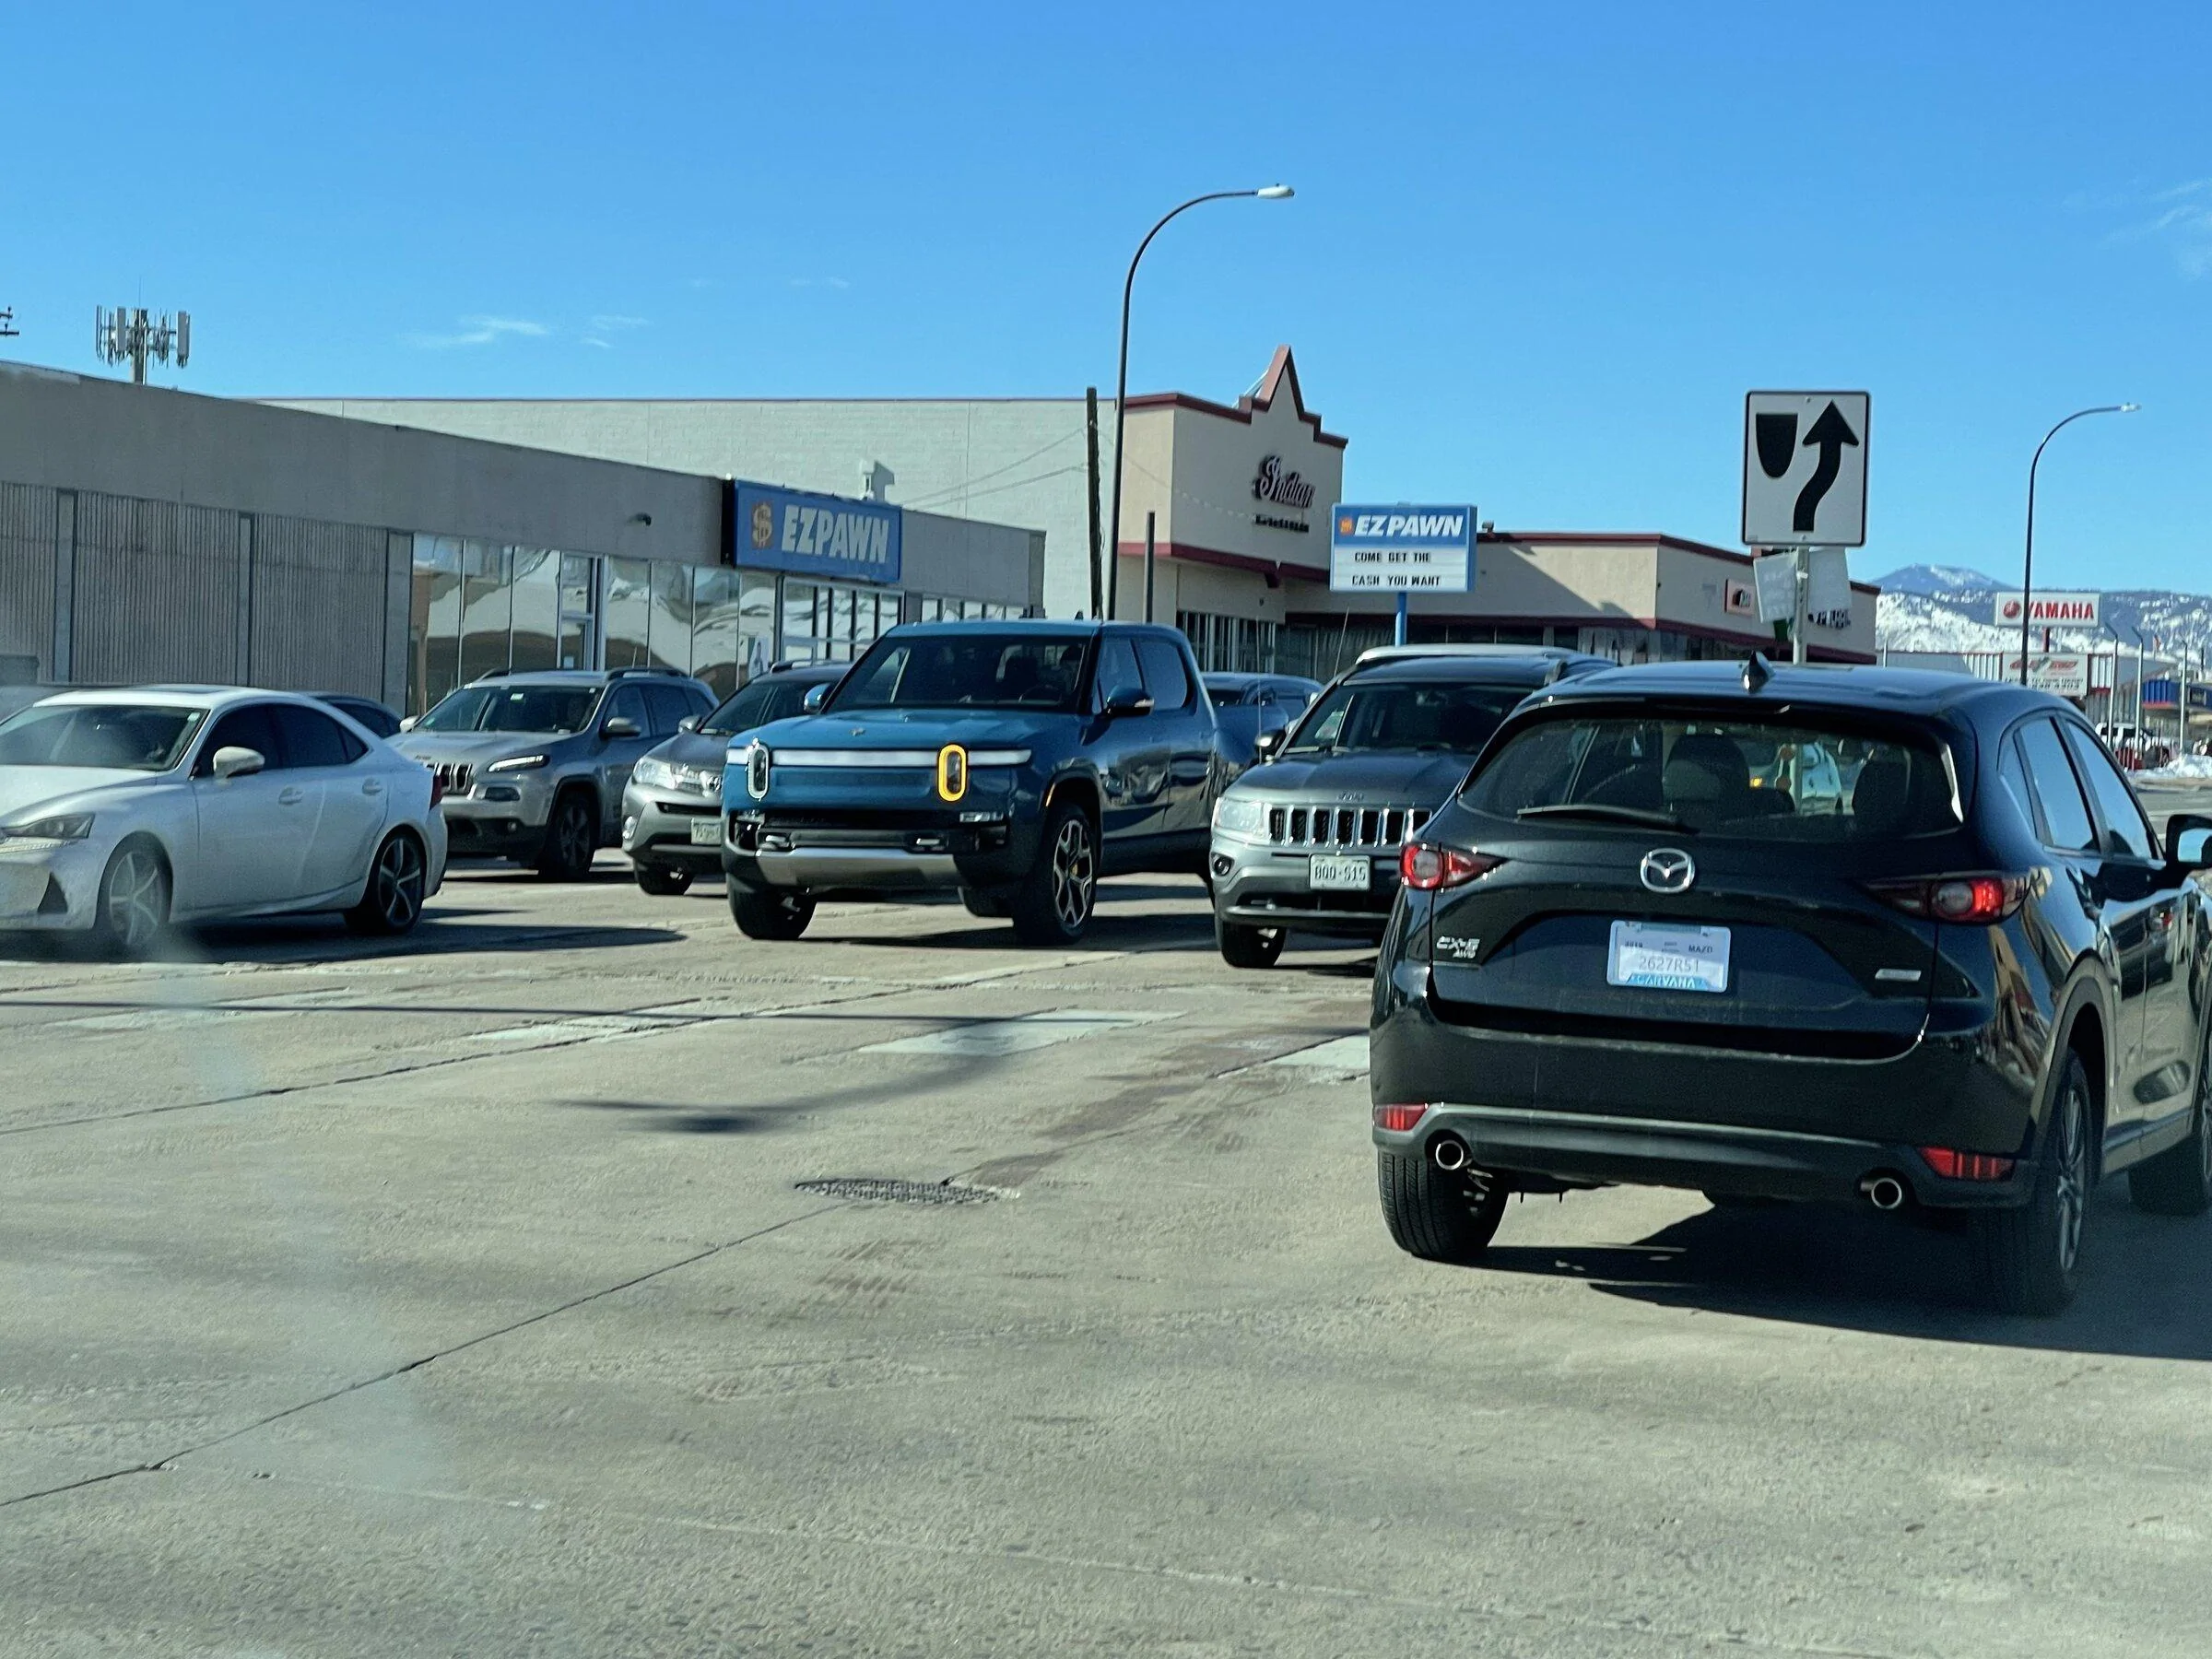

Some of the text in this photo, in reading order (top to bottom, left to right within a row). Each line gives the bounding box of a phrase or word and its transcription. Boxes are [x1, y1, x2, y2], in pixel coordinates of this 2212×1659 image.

[782, 504, 888, 563] EZPAWN
[1354, 514, 1464, 536] EZPAWN
[1354, 552, 1430, 563] COME GET THE
[1352, 575, 1440, 586] CASH YOU WANT
[2027, 602, 2094, 619] YAMAHA
